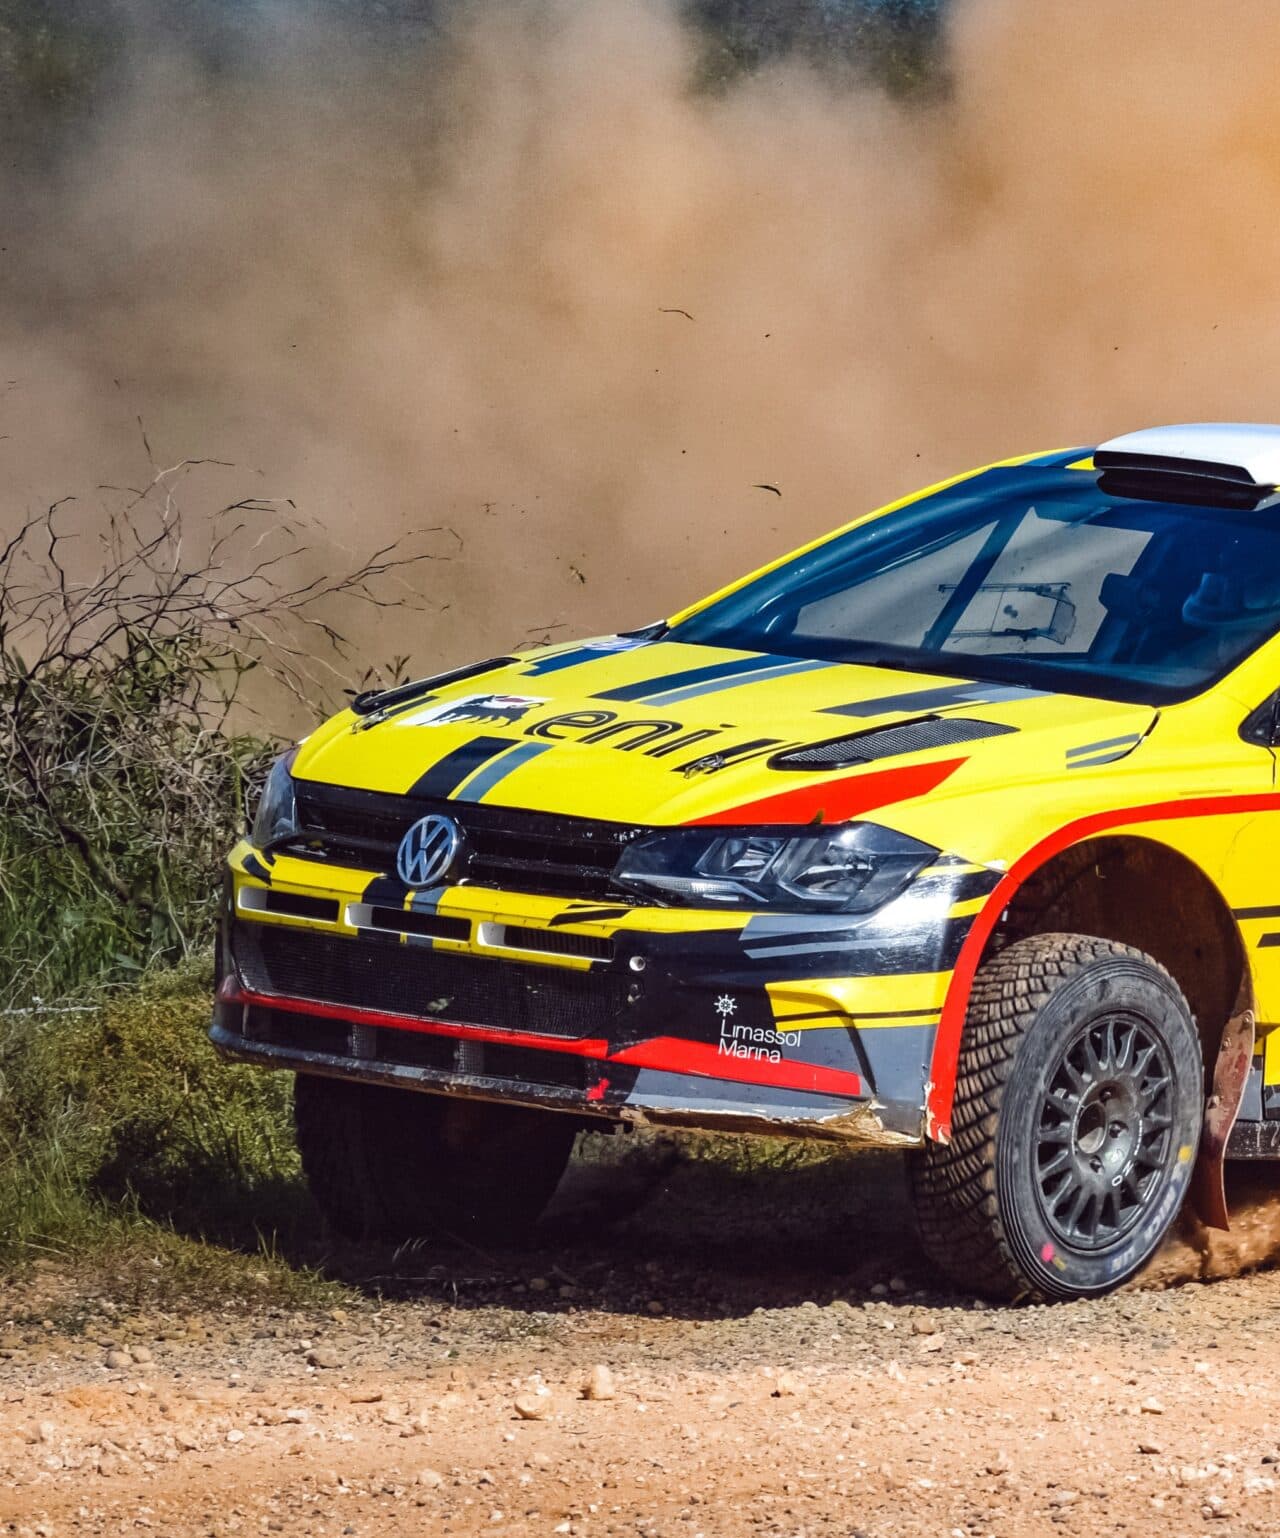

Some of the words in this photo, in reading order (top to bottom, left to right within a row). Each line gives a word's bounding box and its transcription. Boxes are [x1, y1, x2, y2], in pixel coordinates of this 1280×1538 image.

[523, 710, 737, 758] eni
[720, 1019, 802, 1048] Limassol
[718, 1038, 781, 1064] Marina
